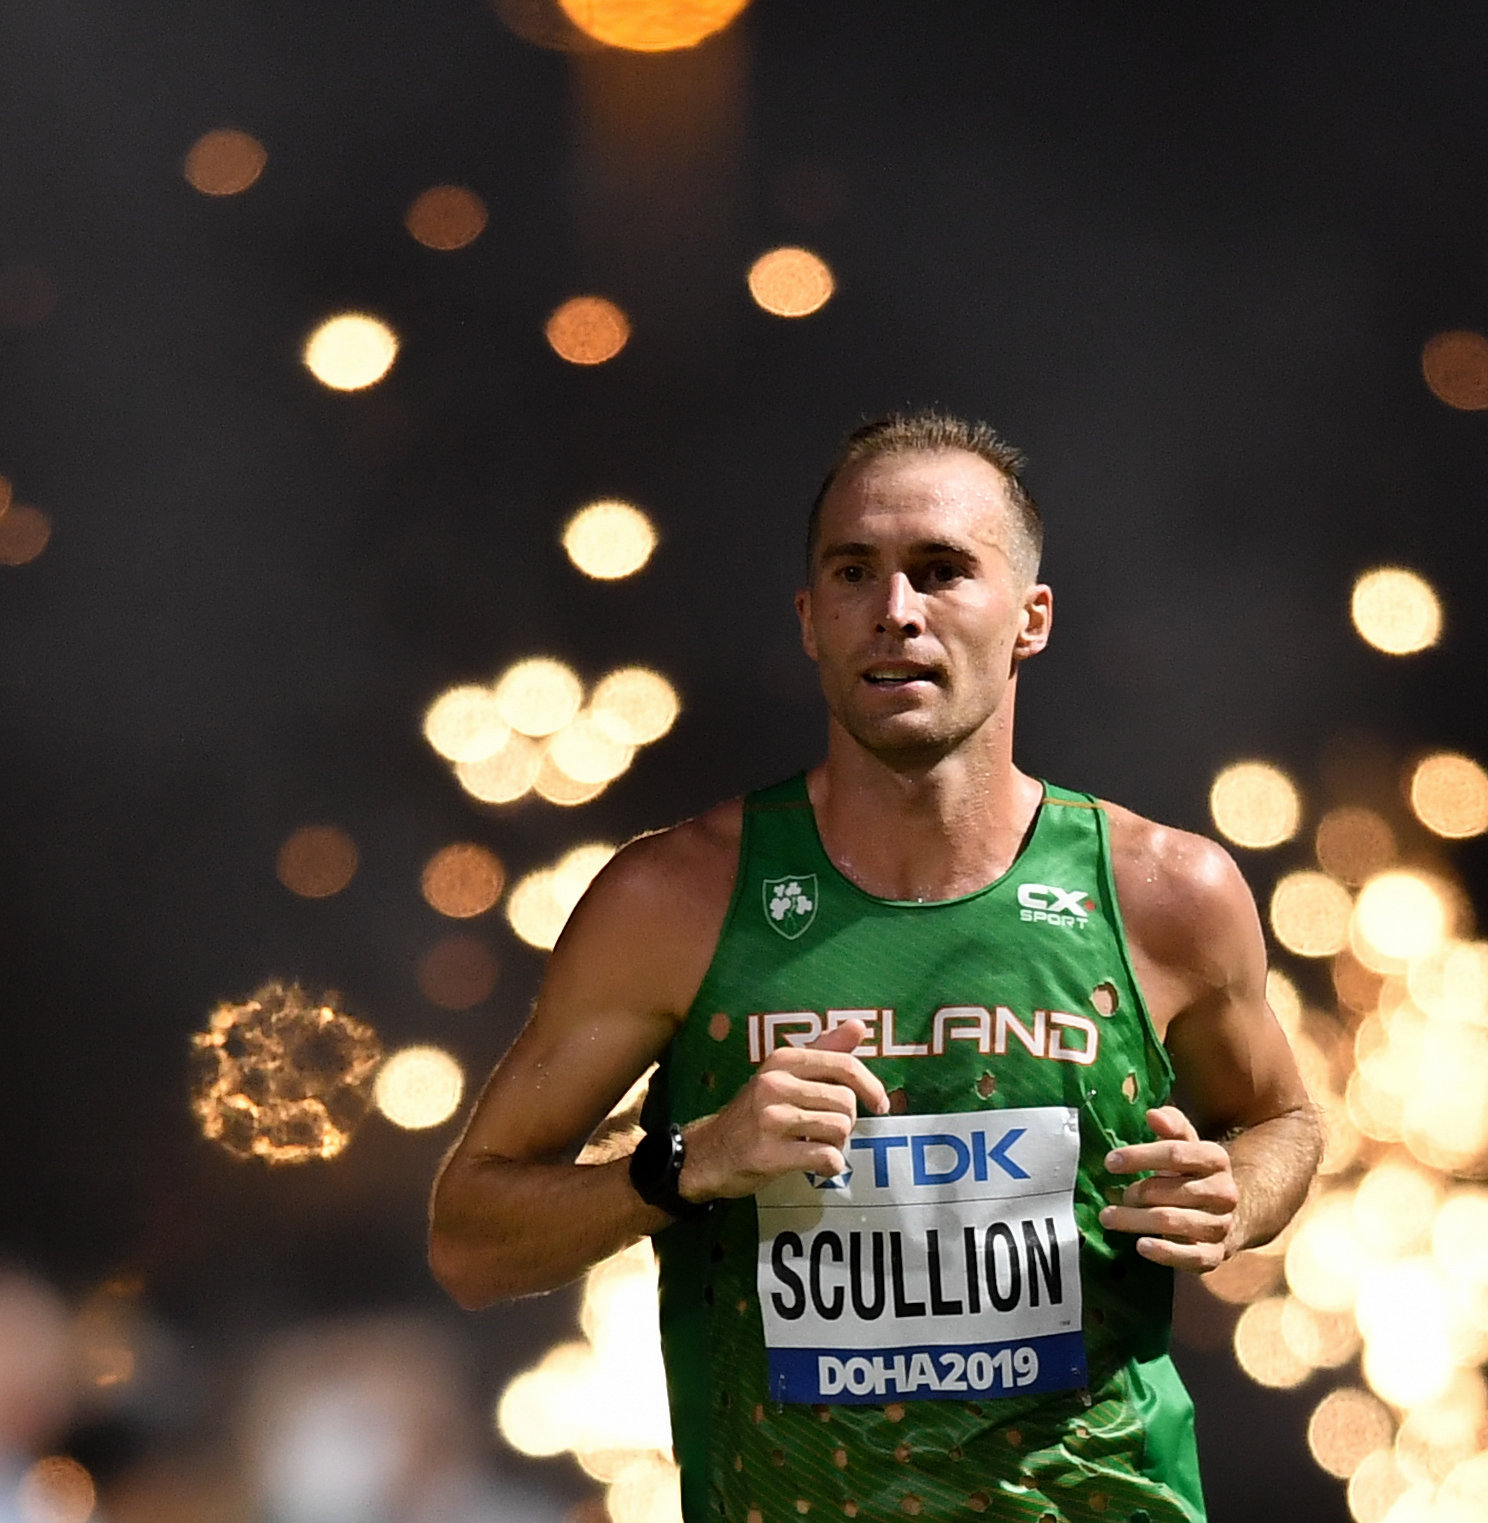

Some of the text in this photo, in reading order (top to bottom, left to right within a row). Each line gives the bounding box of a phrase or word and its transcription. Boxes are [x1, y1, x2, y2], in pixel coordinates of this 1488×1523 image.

[1017, 883, 1089, 918] CX
[1019, 908, 1089, 930] SPORT
[849, 1127, 1032, 1189] TDK
[770, 1217, 1063, 1321] SCULLION
[817, 1346, 1040, 1396] DOHA2019
